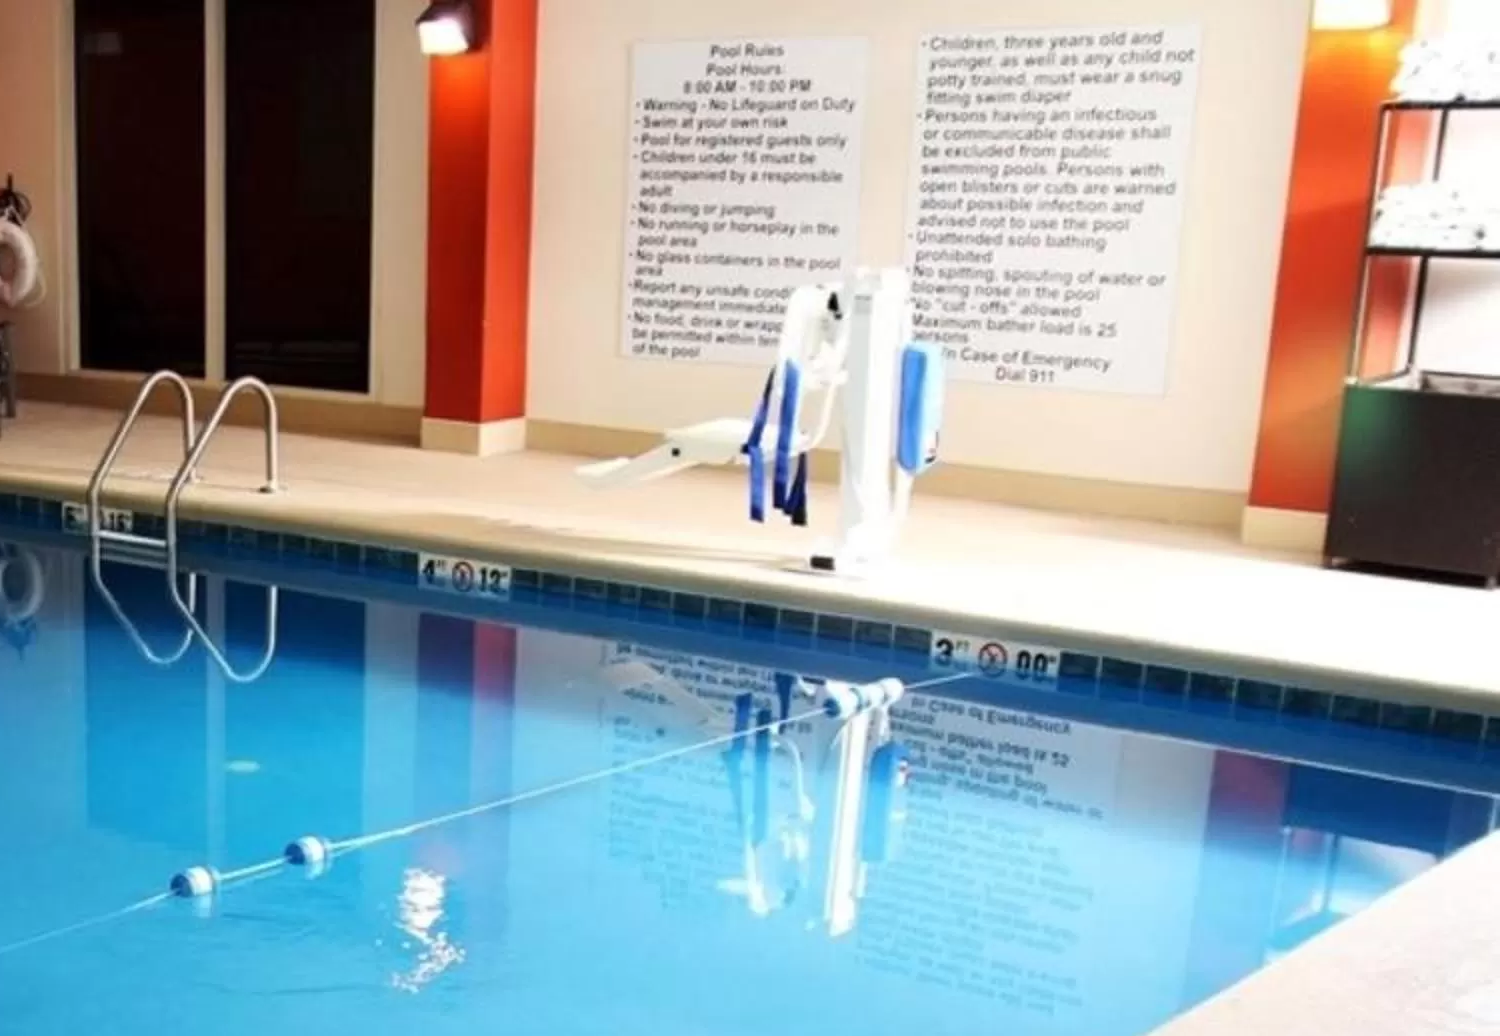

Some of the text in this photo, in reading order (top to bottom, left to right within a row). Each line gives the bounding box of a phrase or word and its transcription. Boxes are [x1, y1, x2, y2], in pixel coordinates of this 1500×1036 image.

[1004, 35, 1044, 50] three
[1049, 33, 1094, 51] years
[1099, 31, 1126, 47] old
[1131, 31, 1163, 45] and
[710, 43, 784, 58] Pool Rules
[1000, 55, 1019, 68] as
[1025, 51, 1055, 67] well
[1060, 54, 1079, 66] as
[1083, 53, 1113, 69] any
[1118, 49, 1161, 65] child
[1165, 48, 1195, 63] not
[706, 63, 782, 76] Pool Hours
[715, 80, 737, 93] AM
[790, 79, 811, 92] PM
[927, 74, 965, 90] potty
[1033, 72, 1076, 86] must
[1080, 71, 1119, 84] wear
[1124, 71, 1135, 83] a
[1140, 69, 1183, 87] snug
[643, 98, 856, 113] Warning No Lifeguard on Duty
[927, 90, 1072, 108] fitting swim diaper
[643, 116, 787, 131] Swim at your own risk
[924, 107, 1157, 125] Persons having an infectious
[640, 133, 847, 149] Pool for registered guests only
[923, 125, 1171, 141] or communicable disease shall
[640, 151, 695, 164] Children
[699, 152, 738, 164] under
[760, 153, 796, 165] must
[799, 152, 816, 165] be
[922, 145, 939, 158] be
[944, 145, 1015, 159] excluded
[1019, 145, 1056, 158] from
[640, 169, 727, 183] accompanied
[730, 169, 746, 184] by
[750, 172, 758, 182] a
[921, 162, 999, 178] swimming
[1057, 162, 1124, 176] Persons
[1129, 162, 1165, 176] with
[640, 186, 673, 197] adult
[920, 181, 1176, 195] open blisters or cuts are warned
[639, 202, 775, 219] No diving or jumping
[920, 199, 1144, 214] about possible infection and
[638, 218, 839, 237] No running or horseplay in the
[917, 217, 1130, 233] advised not to use the pool
[637, 234, 697, 248] pool area
[916, 233, 1107, 253] Unattended solo bathing
[636, 250, 840, 271] No glass containers in the pool
[915, 251, 994, 264] prohibited
[635, 265, 663, 276] area
[913, 266, 934, 279] No
[1004, 270, 1073, 286] spouting
[1077, 271, 1095, 284] of
[1098, 273, 1143, 286] water
[1147, 274, 1166, 287] or
[633, 279, 676, 295] Report
[679, 282, 701, 297] any
[706, 284, 749, 297] unsafe
[911, 282, 1101, 302] blowing nose in the pool
[632, 297, 715, 311] management
[1020, 303, 1082, 318] allowed
[633, 312, 651, 324] No
[690, 316, 722, 329] drink
[726, 318, 740, 329] or
[912, 314, 982, 330] Maximum
[987, 318, 1034, 332] bather
[1040, 321, 1074, 335] load
[1079, 322, 1092, 336] is
[632, 327, 647, 340] be
[651, 329, 712, 343] permitted
[716, 332, 755, 345] within
[632, 343, 700, 359] of the pool
[960, 348, 998, 363] Case
[1002, 351, 1018, 364] of
[1022, 351, 1111, 372] Emergency
[995, 367, 1055, 383] Dial 911
